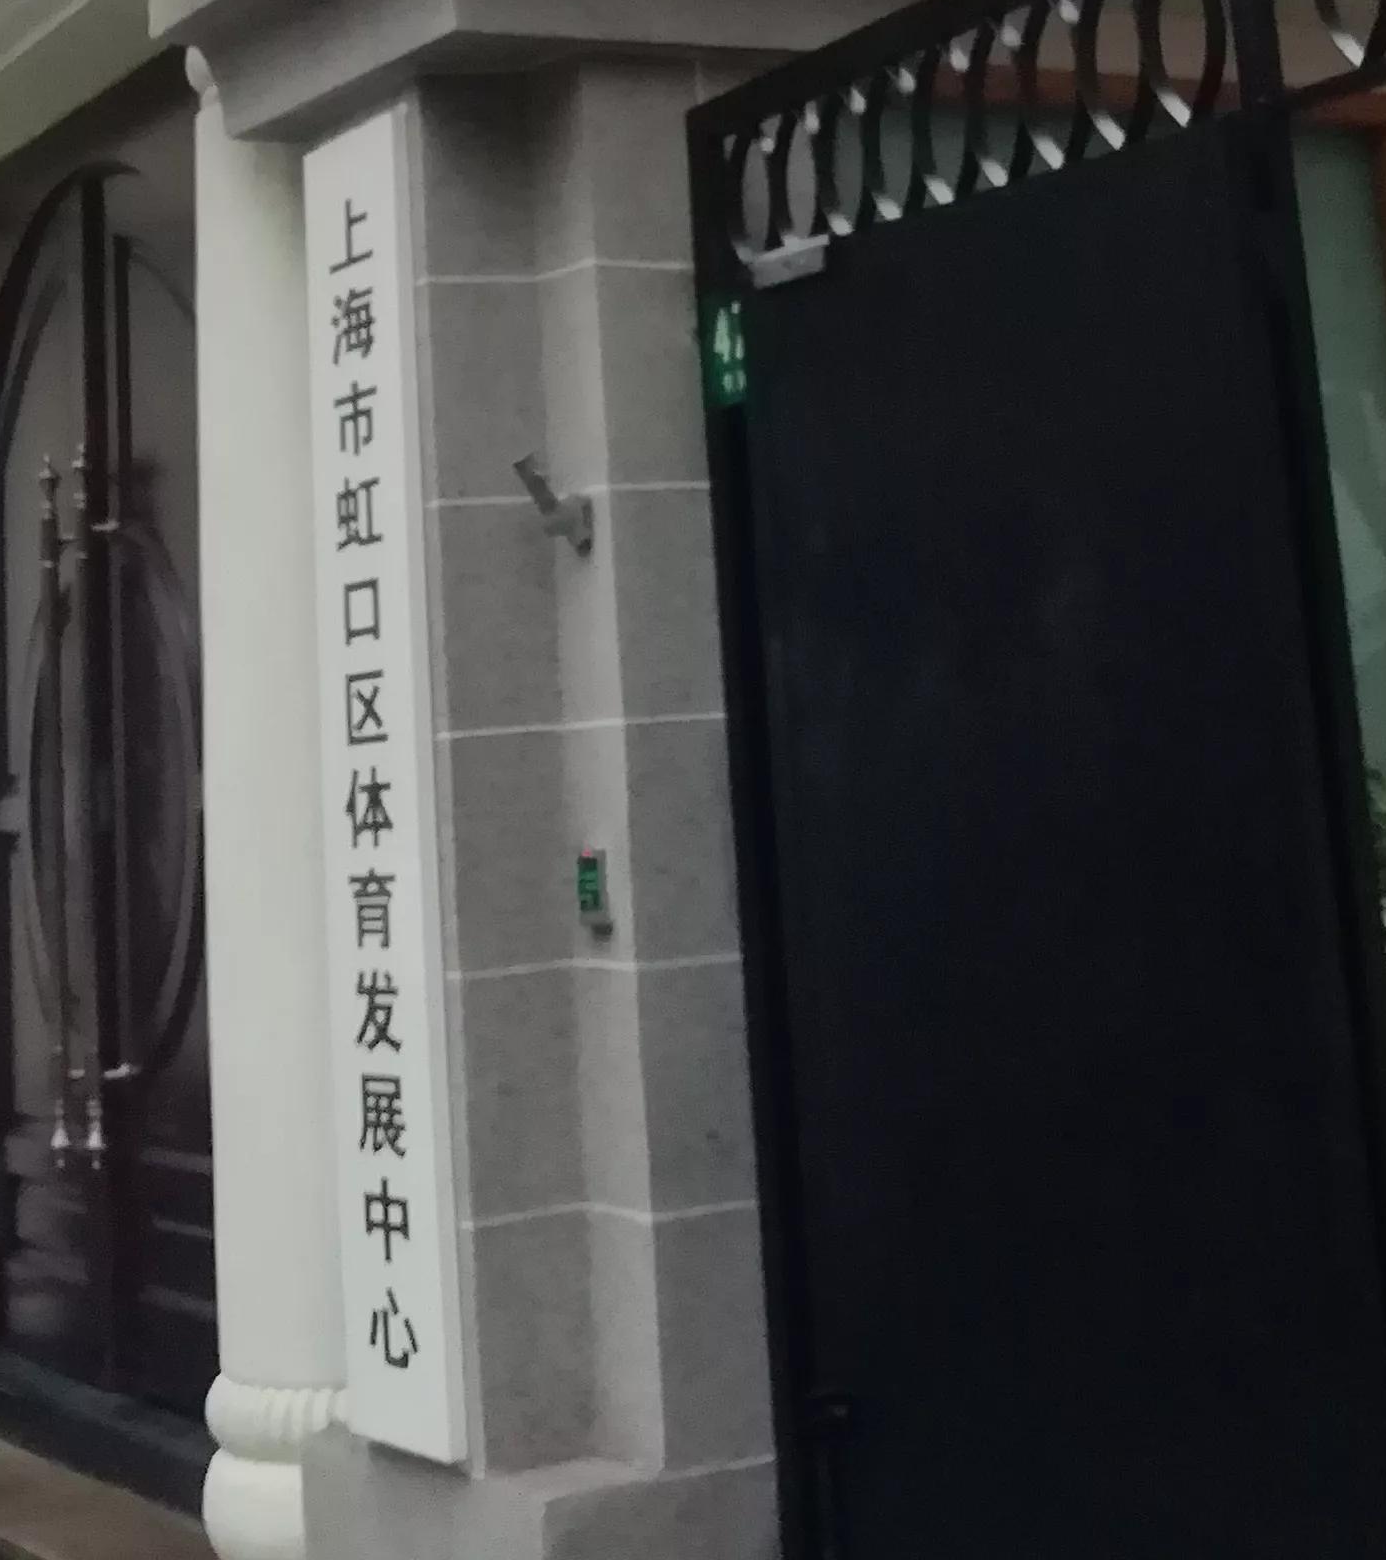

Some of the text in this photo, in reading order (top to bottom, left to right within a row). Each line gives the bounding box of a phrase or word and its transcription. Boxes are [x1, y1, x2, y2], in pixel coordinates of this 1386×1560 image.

[328, 198, 419, 1369] 上海市虹口区体育发展中心
